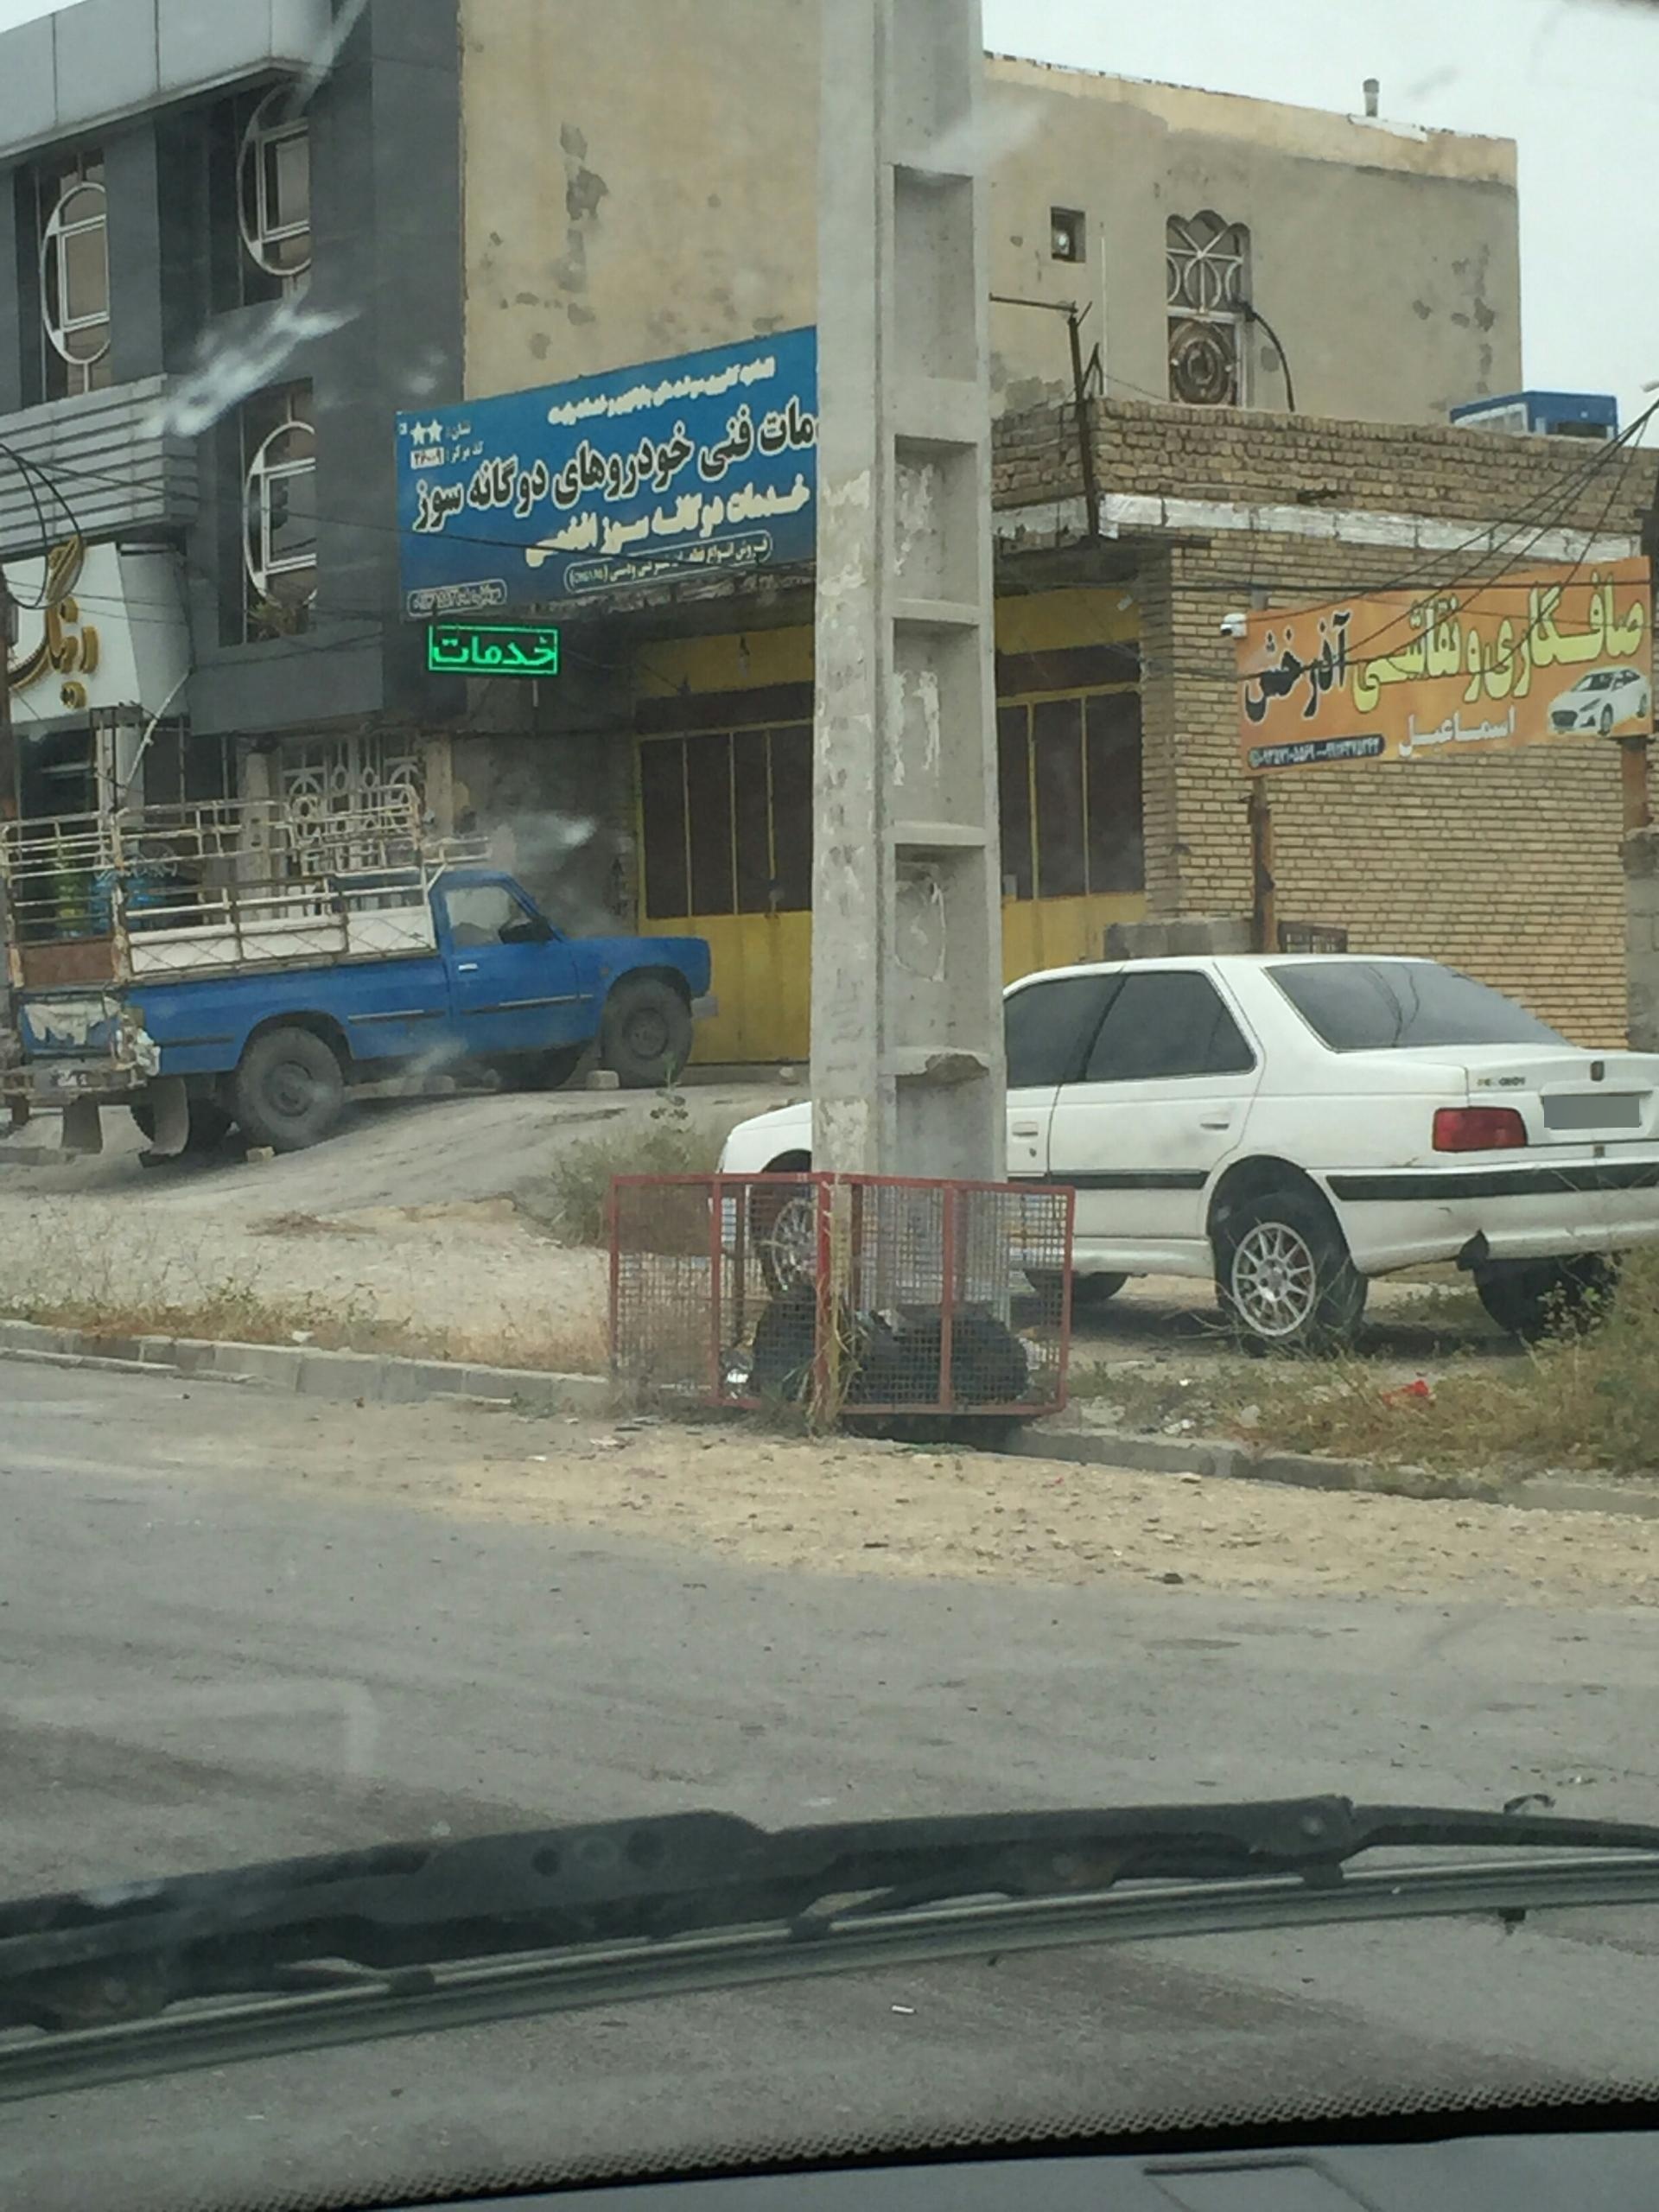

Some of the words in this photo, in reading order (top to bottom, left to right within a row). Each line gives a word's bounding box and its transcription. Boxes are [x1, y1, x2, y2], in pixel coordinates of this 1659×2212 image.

[698, 404, 753, 481] فنی
[757, 395, 819, 456] مات
[553, 420, 694, 510] خودروهای
[412, 479, 464, 533] سوز
[728, 473, 810, 523] خدمات
[433, 636, 556, 666] خدمات
[1353, 593, 1460, 714] نقاشی
[1484, 569, 1643, 700] صافکاری
[1398, 705, 1516, 757] اسماعیل
